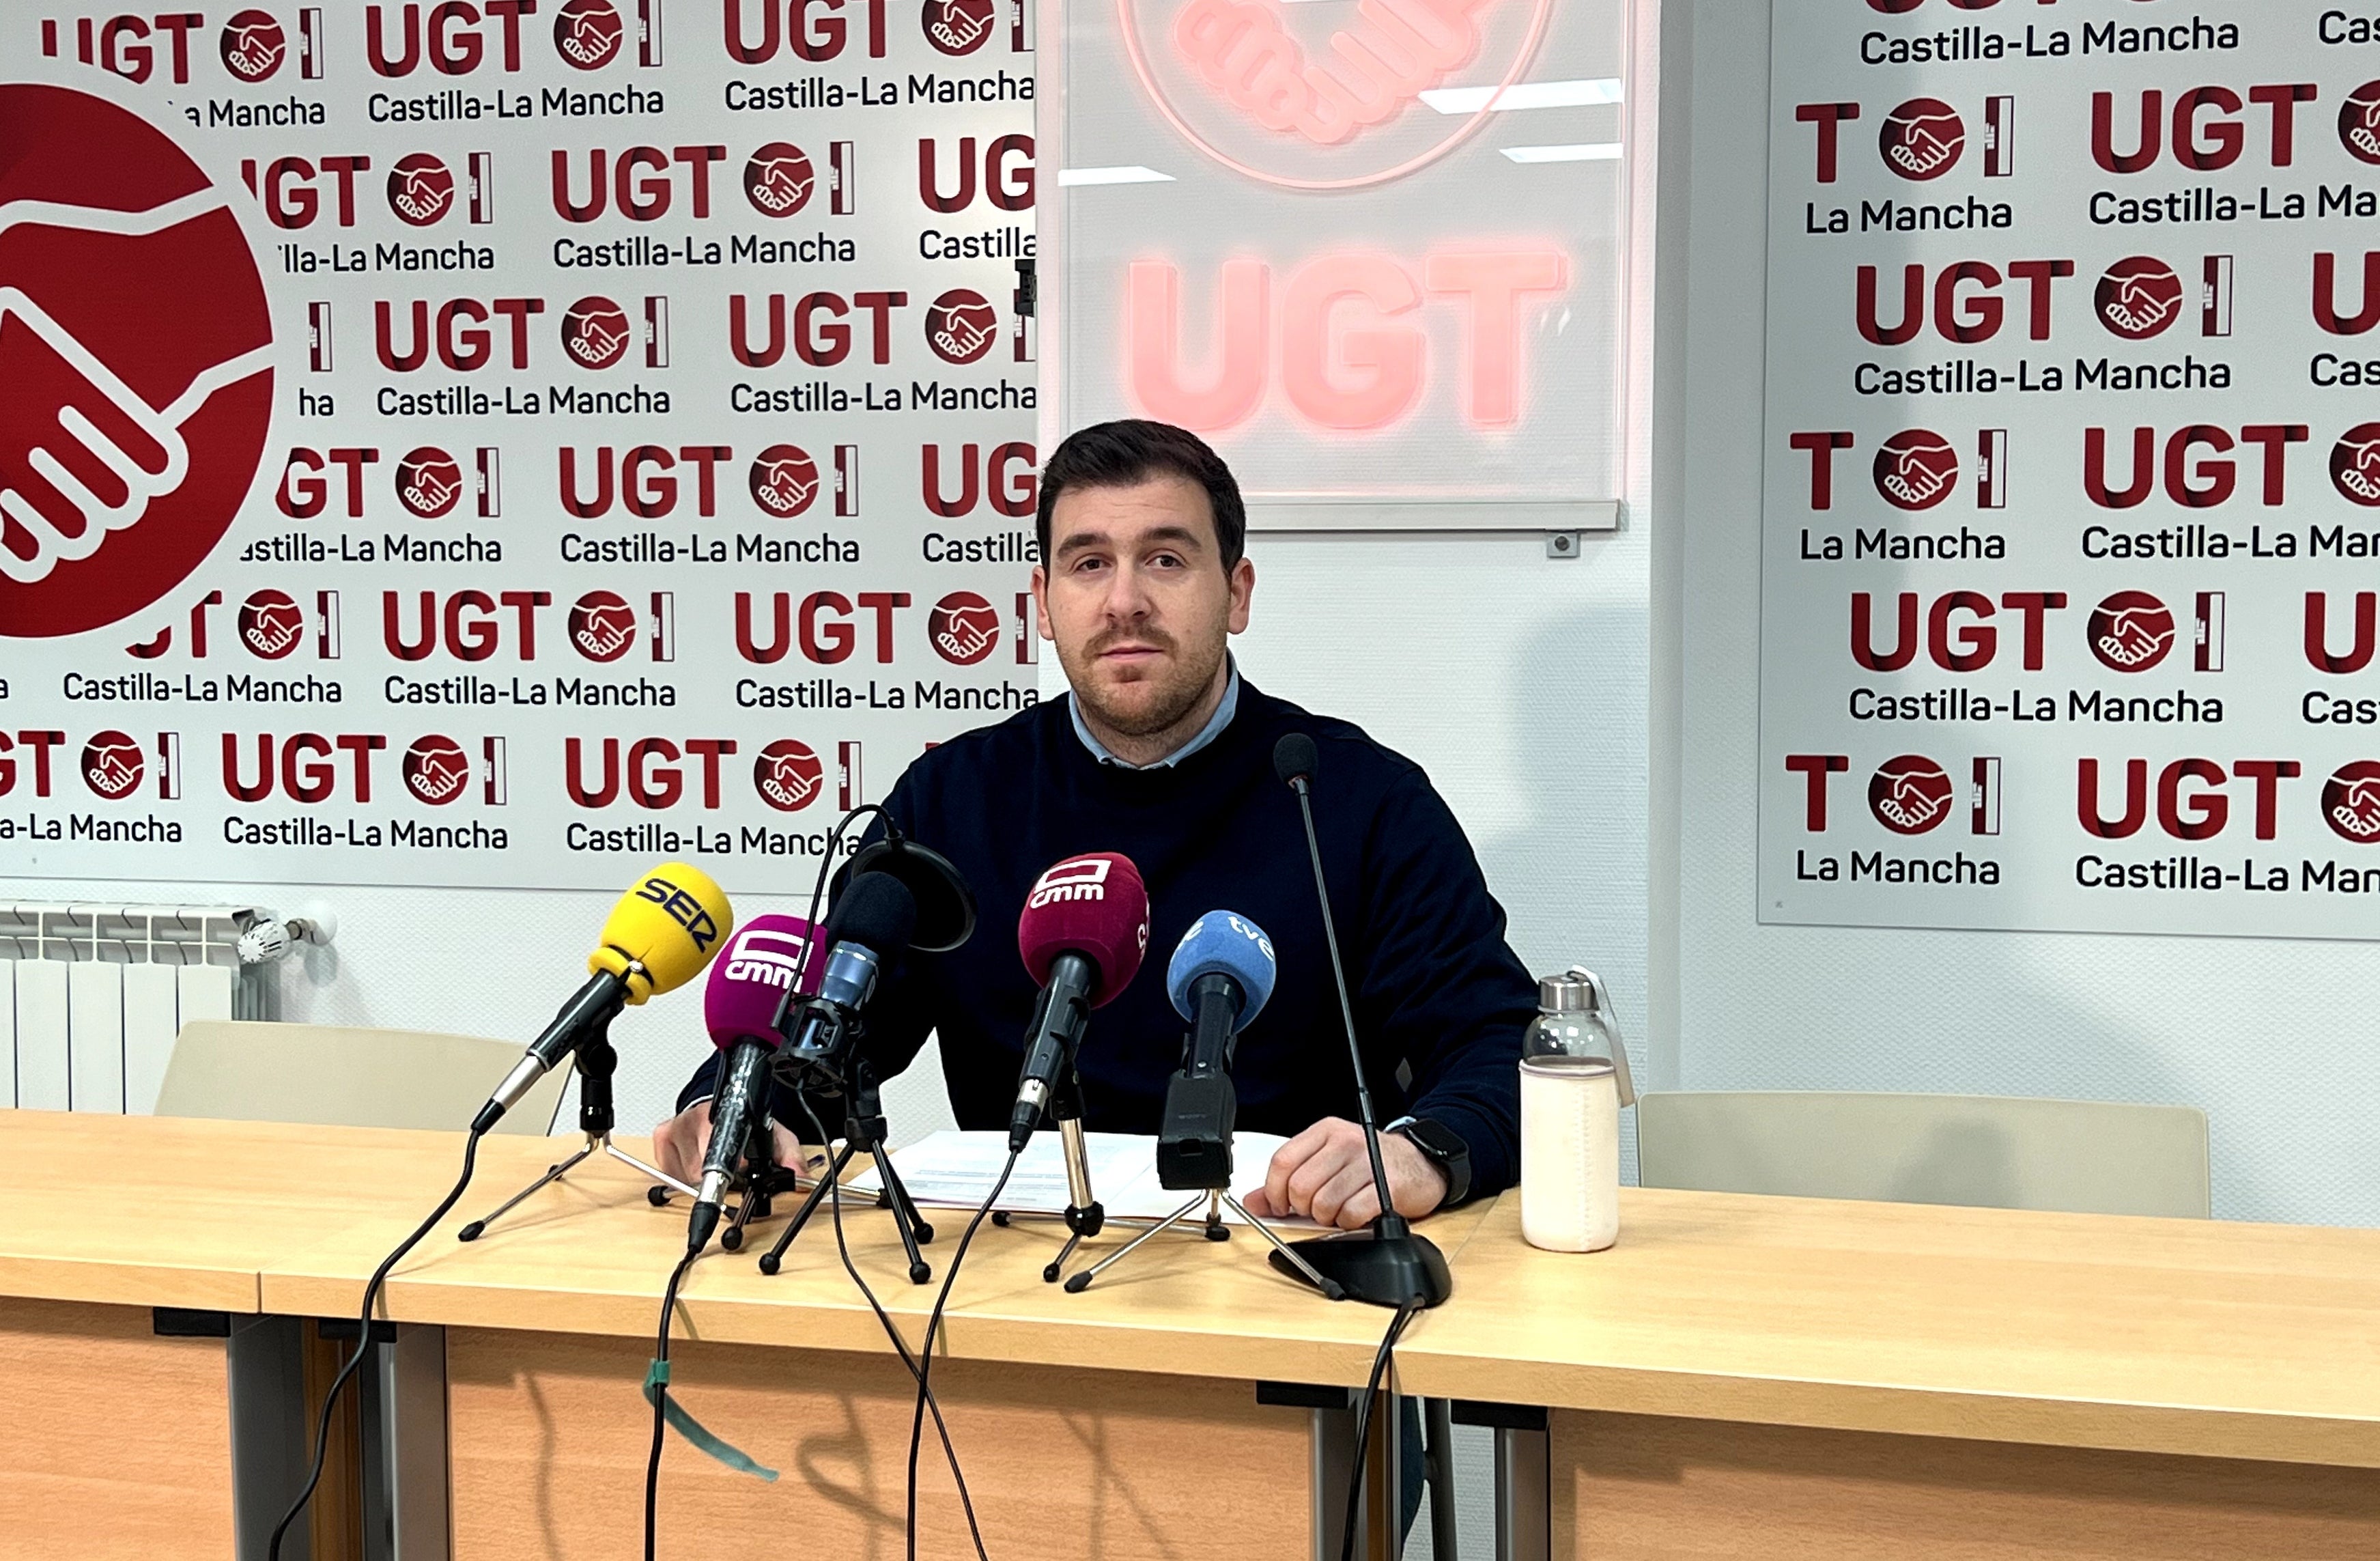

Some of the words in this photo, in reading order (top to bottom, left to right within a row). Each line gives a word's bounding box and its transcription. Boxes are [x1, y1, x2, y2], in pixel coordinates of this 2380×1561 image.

[367, 0, 537, 77] UGT
[1860, 25, 2070, 64] Castilla-La
[2082, 16, 2239, 54] Mancha
[369, 89, 533, 122] Castilla-La
[541, 84, 664, 116] Mancha
[725, 76, 898, 110] Castilla-La
[908, 70, 1034, 103] Mancha
[209, 96, 325, 127] Mancha
[2091, 84, 2317, 173] UGT
[552, 145, 726, 223] UGT
[1861, 196, 2012, 232] Mancha
[2089, 187, 2305, 224] Castilla-La
[376, 240, 494, 270] Mancha
[554, 236, 721, 267] Castilla-La
[731, 232, 855, 263] Mancha
[1856, 260, 2074, 346] UGT
[376, 298, 544, 371] UGT
[731, 292, 907, 368] UGT
[1129, 251, 1562, 430] UGT
[1854, 360, 2063, 395] Castilla-La
[2076, 356, 2230, 391] Mancha
[378, 386, 540, 415] Castilla-La
[550, 384, 670, 414] Mancha
[731, 382, 901, 412] Castilla-La
[912, 379, 1036, 410] Mancha
[560, 446, 732, 519] UGT
[2084, 425, 2309, 509] UGT
[384, 533, 502, 562] Mancha
[561, 533, 726, 562] Castilla-La
[737, 533, 860, 562] Mancha
[1855, 526, 2005, 560] Mancha
[2082, 525, 2297, 559] Castilla-La
[384, 591, 552, 661] UGT
[735, 591, 911, 664] UGT
[1850, 591, 2067, 673] UGT
[63, 673, 218, 701] Castilla-La
[227, 675, 341, 702] Mancha
[385, 675, 547, 705] Castilla-La
[556, 677, 676, 706] Mancha
[736, 679, 905, 709] Castilla-La
[915, 681, 1038, 710] Mancha
[1850, 688, 2056, 721] Castilla-La
[2069, 690, 2223, 722] Mancha
[222, 733, 386, 803] UGT
[565, 738, 737, 809] UGT
[2078, 759, 2301, 841] UGT
[70, 814, 182, 843] Mancha
[224, 817, 382, 847] Castilla-La
[391, 820, 508, 849] Mancha
[567, 823, 731, 853] Castilla-La
[1851, 852, 2000, 885] Mancha
[2076, 855, 2289, 891] Castilla-La
[1030, 884, 1104, 909] cmm
[636, 878, 717, 953] SER
[1228, 916, 1274, 961] tve
[725, 961, 803, 993] cmm
